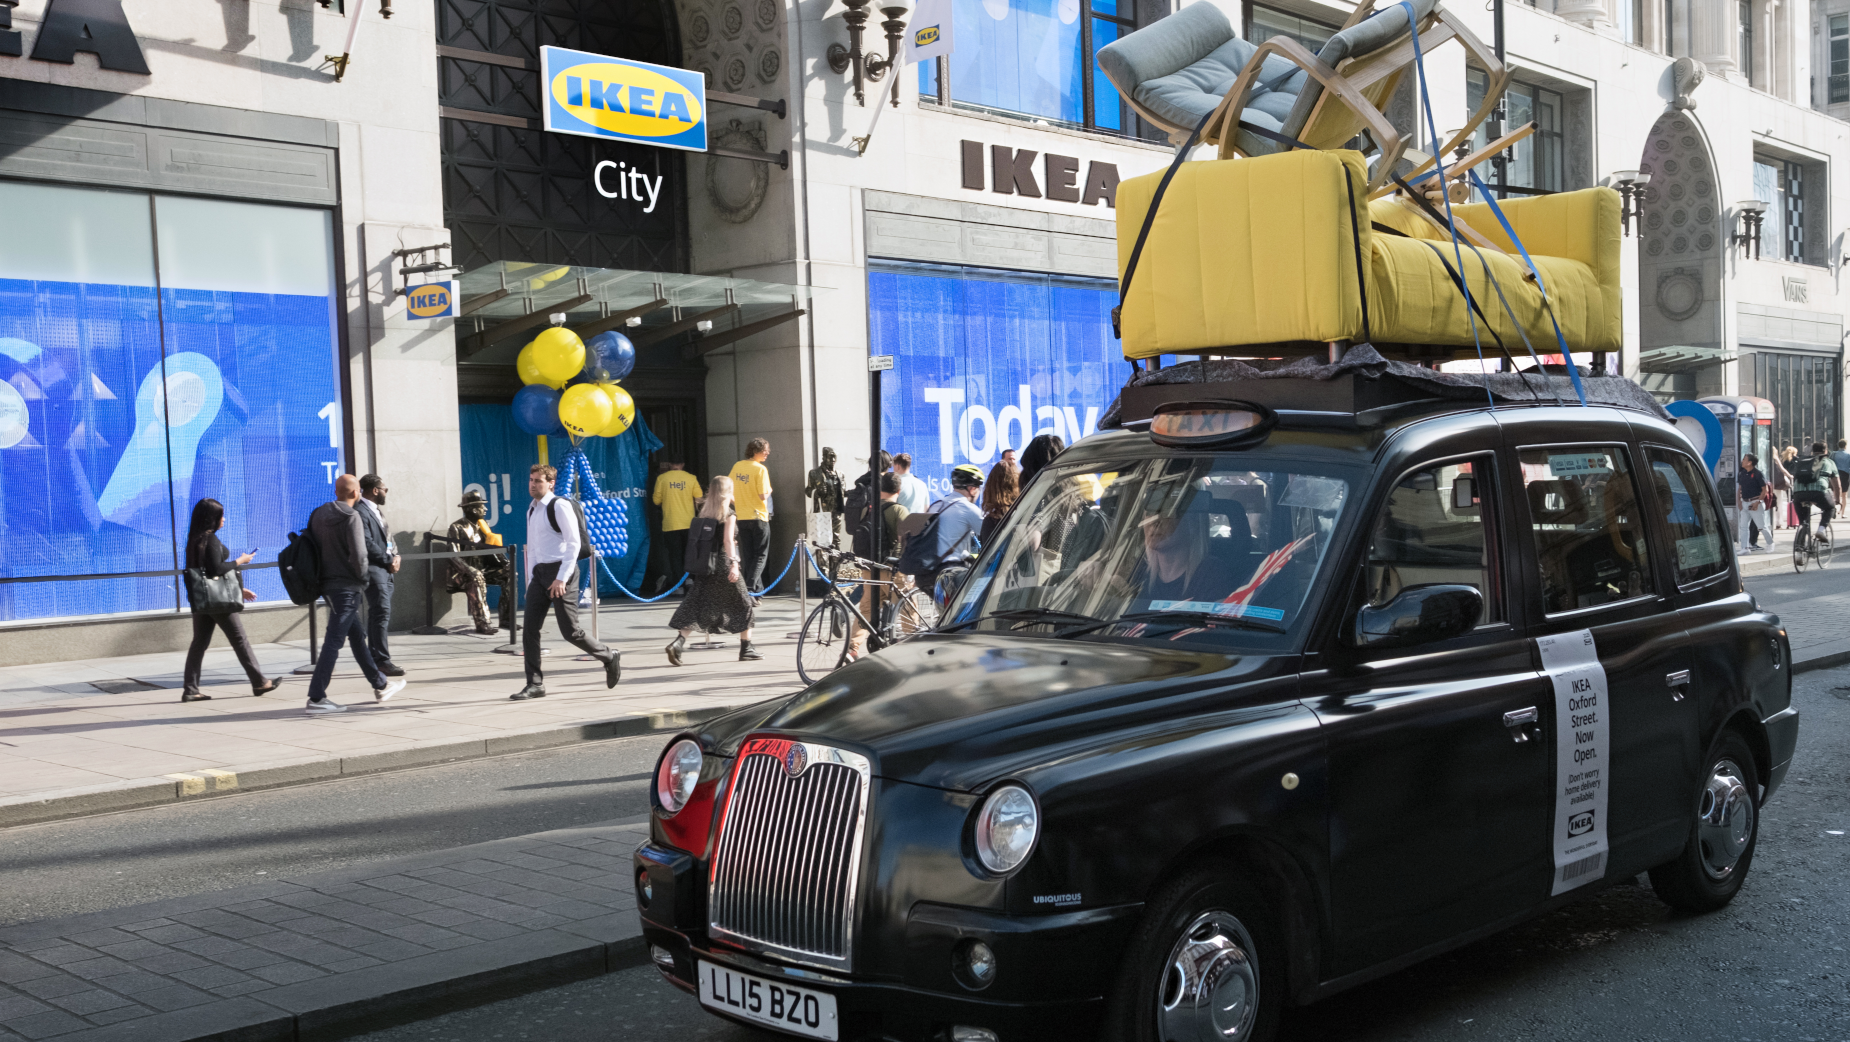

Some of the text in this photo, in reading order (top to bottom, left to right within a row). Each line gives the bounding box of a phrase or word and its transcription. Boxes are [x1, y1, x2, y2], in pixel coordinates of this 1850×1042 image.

[916, 30, 938, 43] IKEA
[566, 75, 693, 123] IKEA
[962, 140, 1121, 208] IKEA
[594, 160, 663, 213] City
[1782, 275, 1808, 304] VANS
[410, 292, 448, 309] IKEA
[564, 420, 584, 433] IKEA
[1166, 410, 1231, 434] TAXI
[669, 481, 686, 491] Hej!
[735, 473, 750, 484] Hej!
[1571, 678, 1591, 693] IKEA
[1568, 692, 1597, 711] Oxford
[1571, 711, 1598, 728] Street.
[1575, 730, 1595, 746] Now
[1573, 747, 1597, 766] Open.
[1584, 769, 1600, 779] worry
[1564, 779, 1601, 796] home delivery
[1570, 790, 1595, 805] available)
[1570, 816, 1592, 831] IKEA
[1033, 893, 1082, 904] UBIQUITOUS
[711, 968, 820, 1029] LL15 BZO
